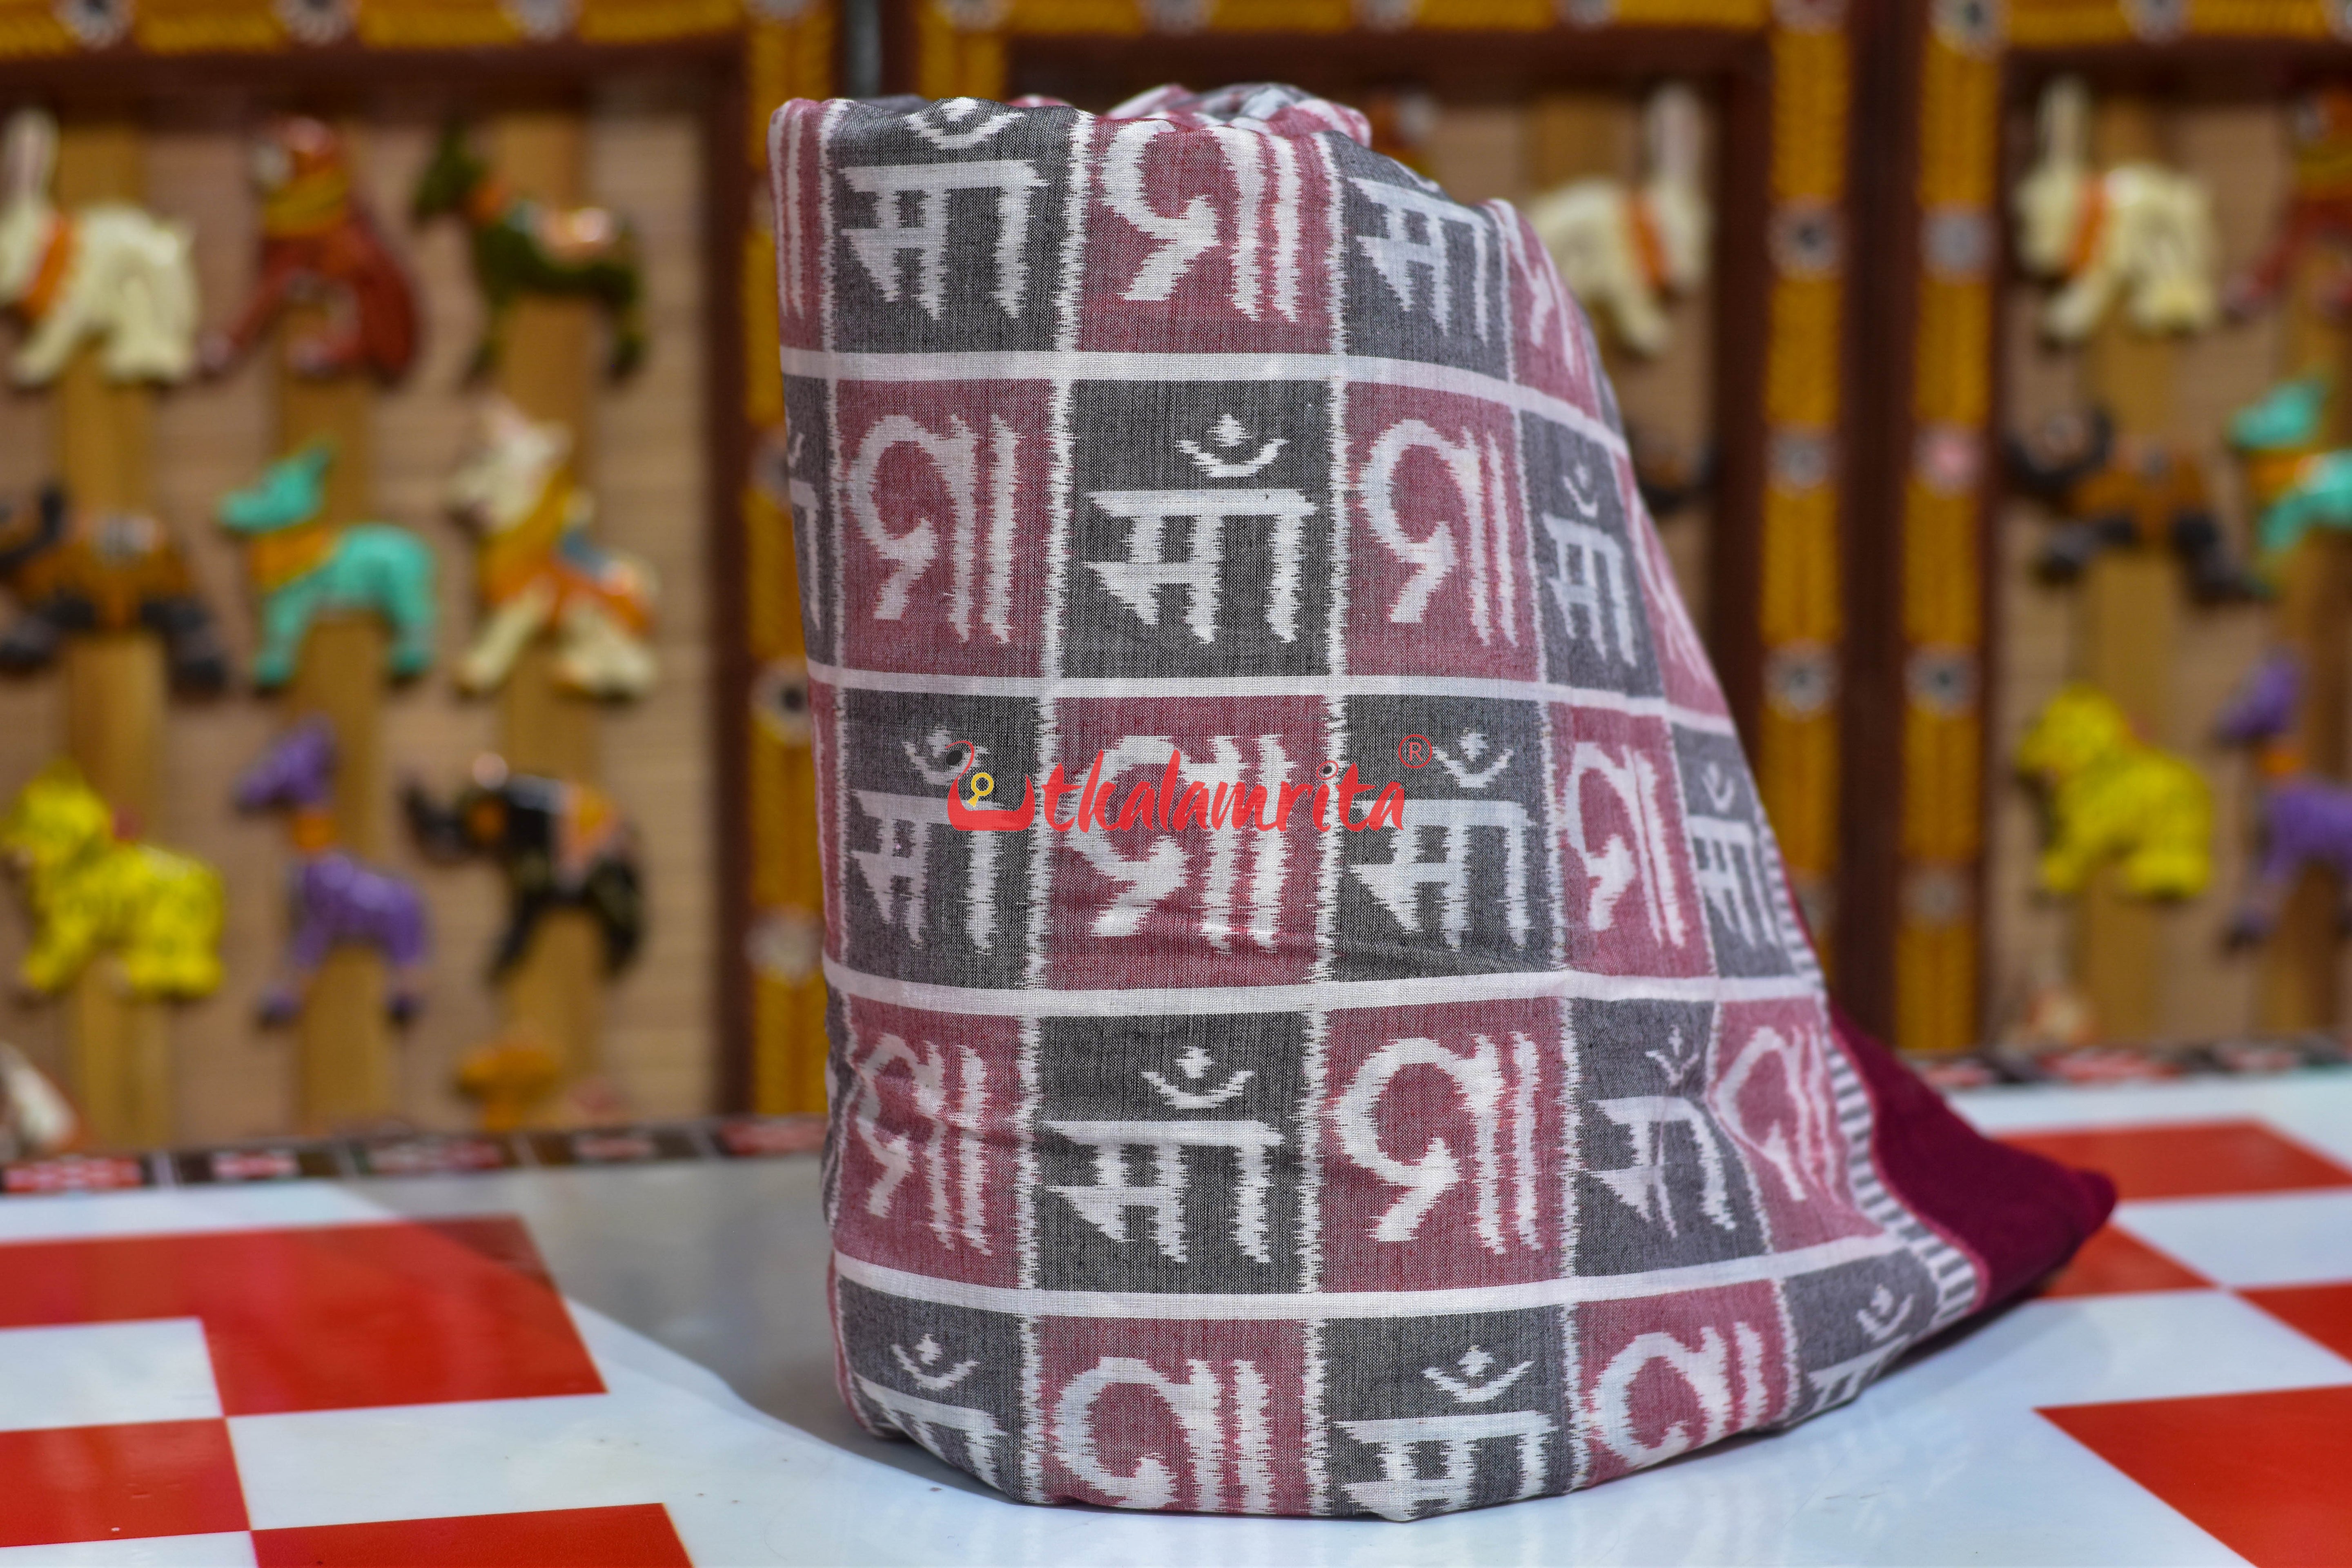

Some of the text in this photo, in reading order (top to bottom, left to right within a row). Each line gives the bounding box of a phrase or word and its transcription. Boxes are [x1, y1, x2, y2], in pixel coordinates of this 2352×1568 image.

[839, 97, 1049, 320] माँ
[1082, 413, 1318, 643] माँ
[1544, 463, 1636, 667] माँ
[1350, 728, 1535, 950] माँ
[1045, 1045, 1282, 1263] माँ
